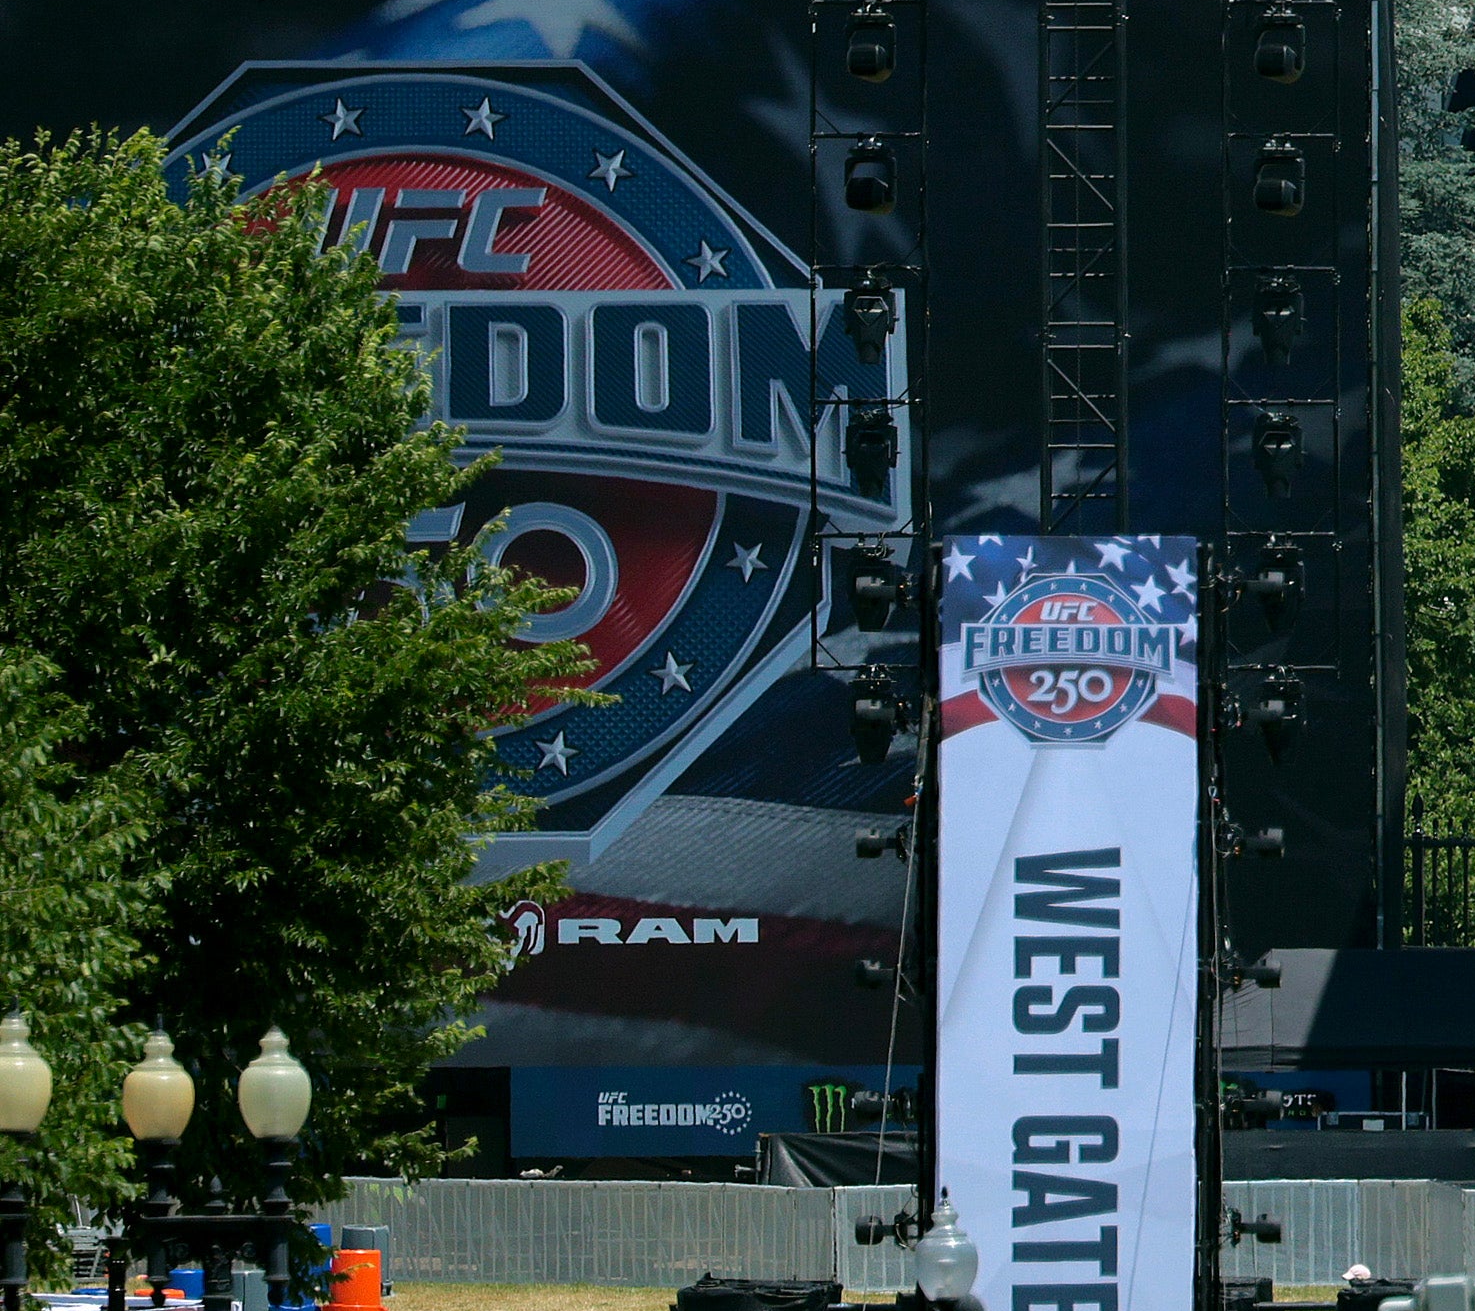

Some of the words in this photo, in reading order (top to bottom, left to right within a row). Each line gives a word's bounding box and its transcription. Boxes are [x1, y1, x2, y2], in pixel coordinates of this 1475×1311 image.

[1040, 601, 1099, 621] UFC
[963, 626, 1171, 672] FREEDOM
[1026, 669, 1114, 715] 250
[557, 917, 760, 945] RAM
[1012, 846, 1122, 1090] WEST
[598, 1091, 628, 1104] UFC
[598, 1103, 714, 1127] FREEDOM
[709, 1103, 746, 1125] 250
